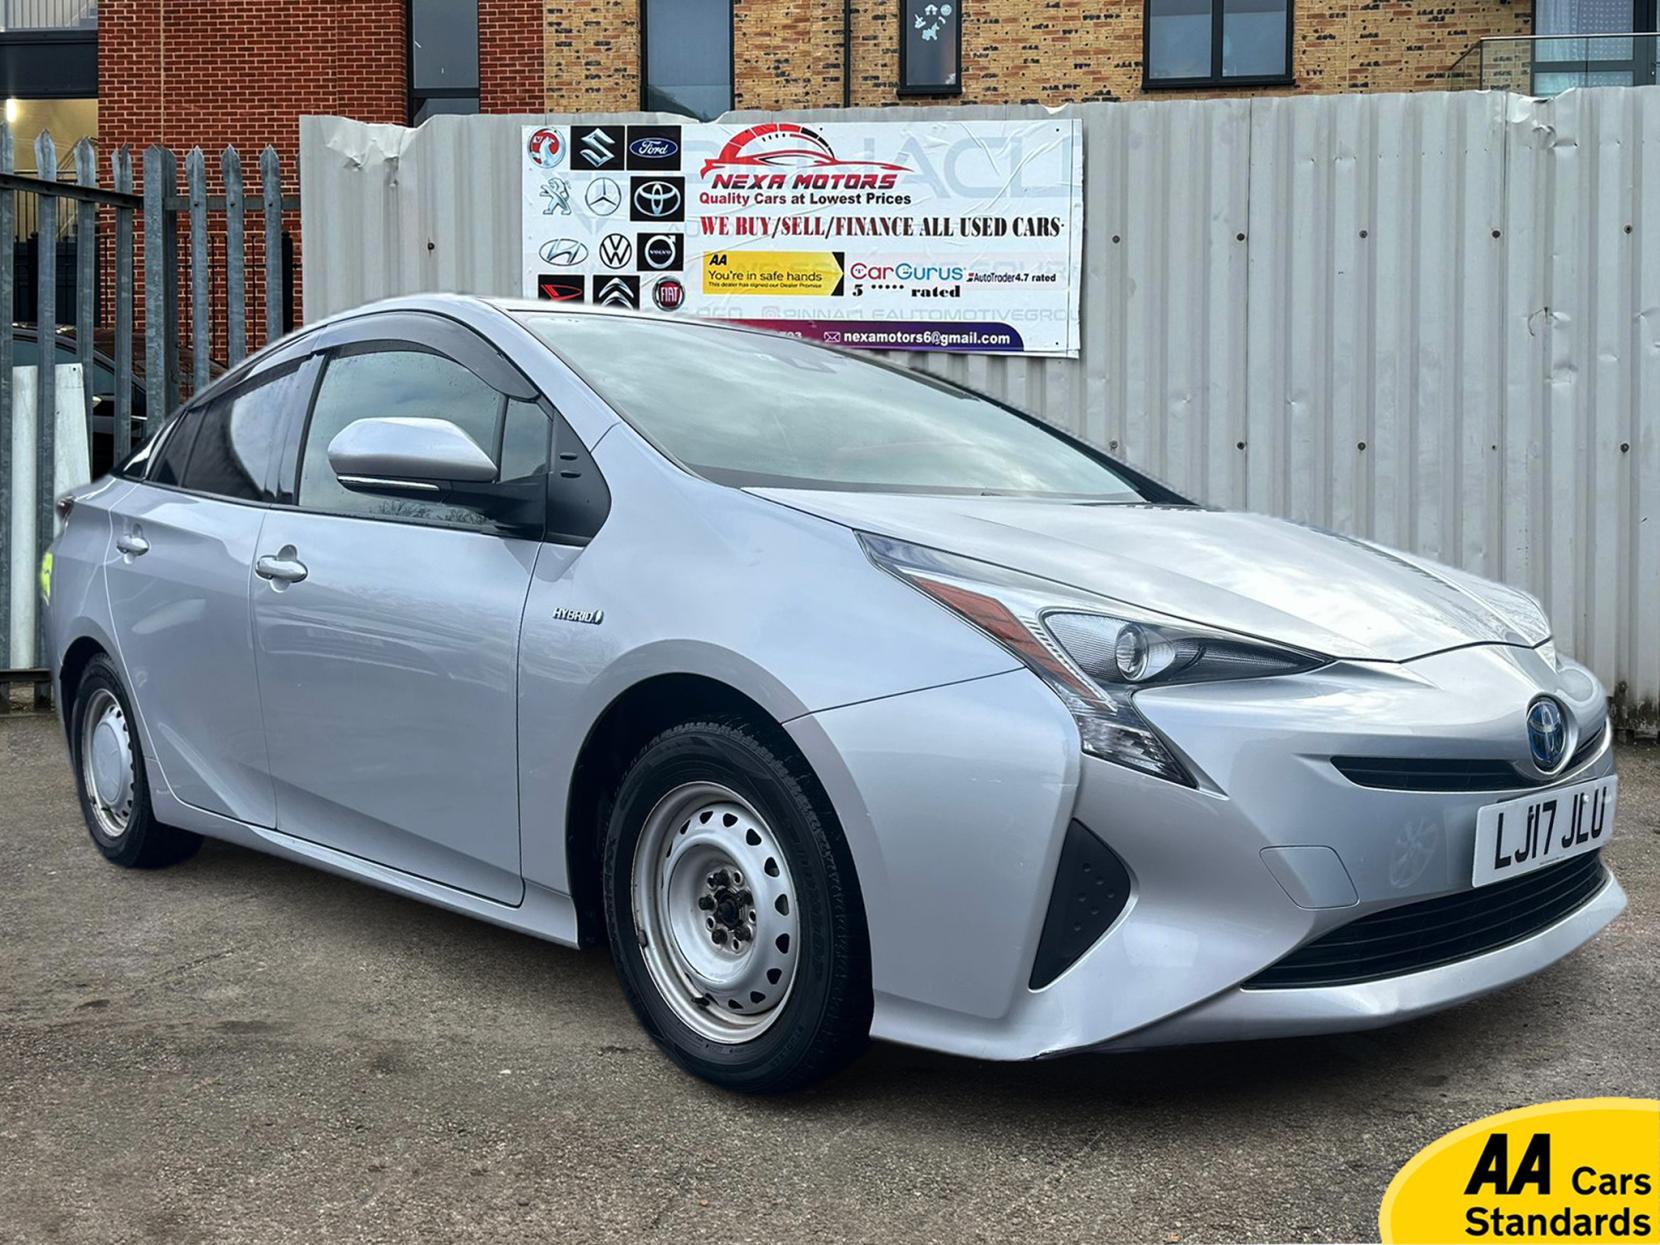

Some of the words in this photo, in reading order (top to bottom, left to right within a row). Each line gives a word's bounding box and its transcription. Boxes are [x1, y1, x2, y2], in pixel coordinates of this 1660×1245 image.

[639, 140, 669, 155] Ford
[711, 174, 787, 190] NEXA
[791, 174, 898, 190] MOTORS
[699, 192, 750, 206] Quality
[754, 192, 786, 205] Cars
[791, 193, 806, 205] at
[809, 192, 862, 205] Lowest
[866, 192, 912, 205] Prices
[700, 216, 729, 236] WE
[735, 216, 914, 239] BUY/SELL/FINANCE
[919, 217, 954, 237] ALL
[959, 217, 1008, 237] USED
[709, 254, 728, 266] AA
[708, 270, 745, 281] You're
[746, 270, 758, 281] in
[759, 271, 785, 281] safe
[786, 271, 823, 282] hands
[850, 262, 964, 281] CarGurus
[1032, 273, 1057, 282] rated
[660, 286, 680, 303] FIAT
[852, 284, 864, 297] 5
[911, 285, 961, 298] rated
[843, 330, 1011, 346] nexamotors6@gmail.com
[552, 607, 593, 622] HYBRID
[1494, 800, 1558, 870] LJ17
[1561, 786, 1607, 849] JLU
